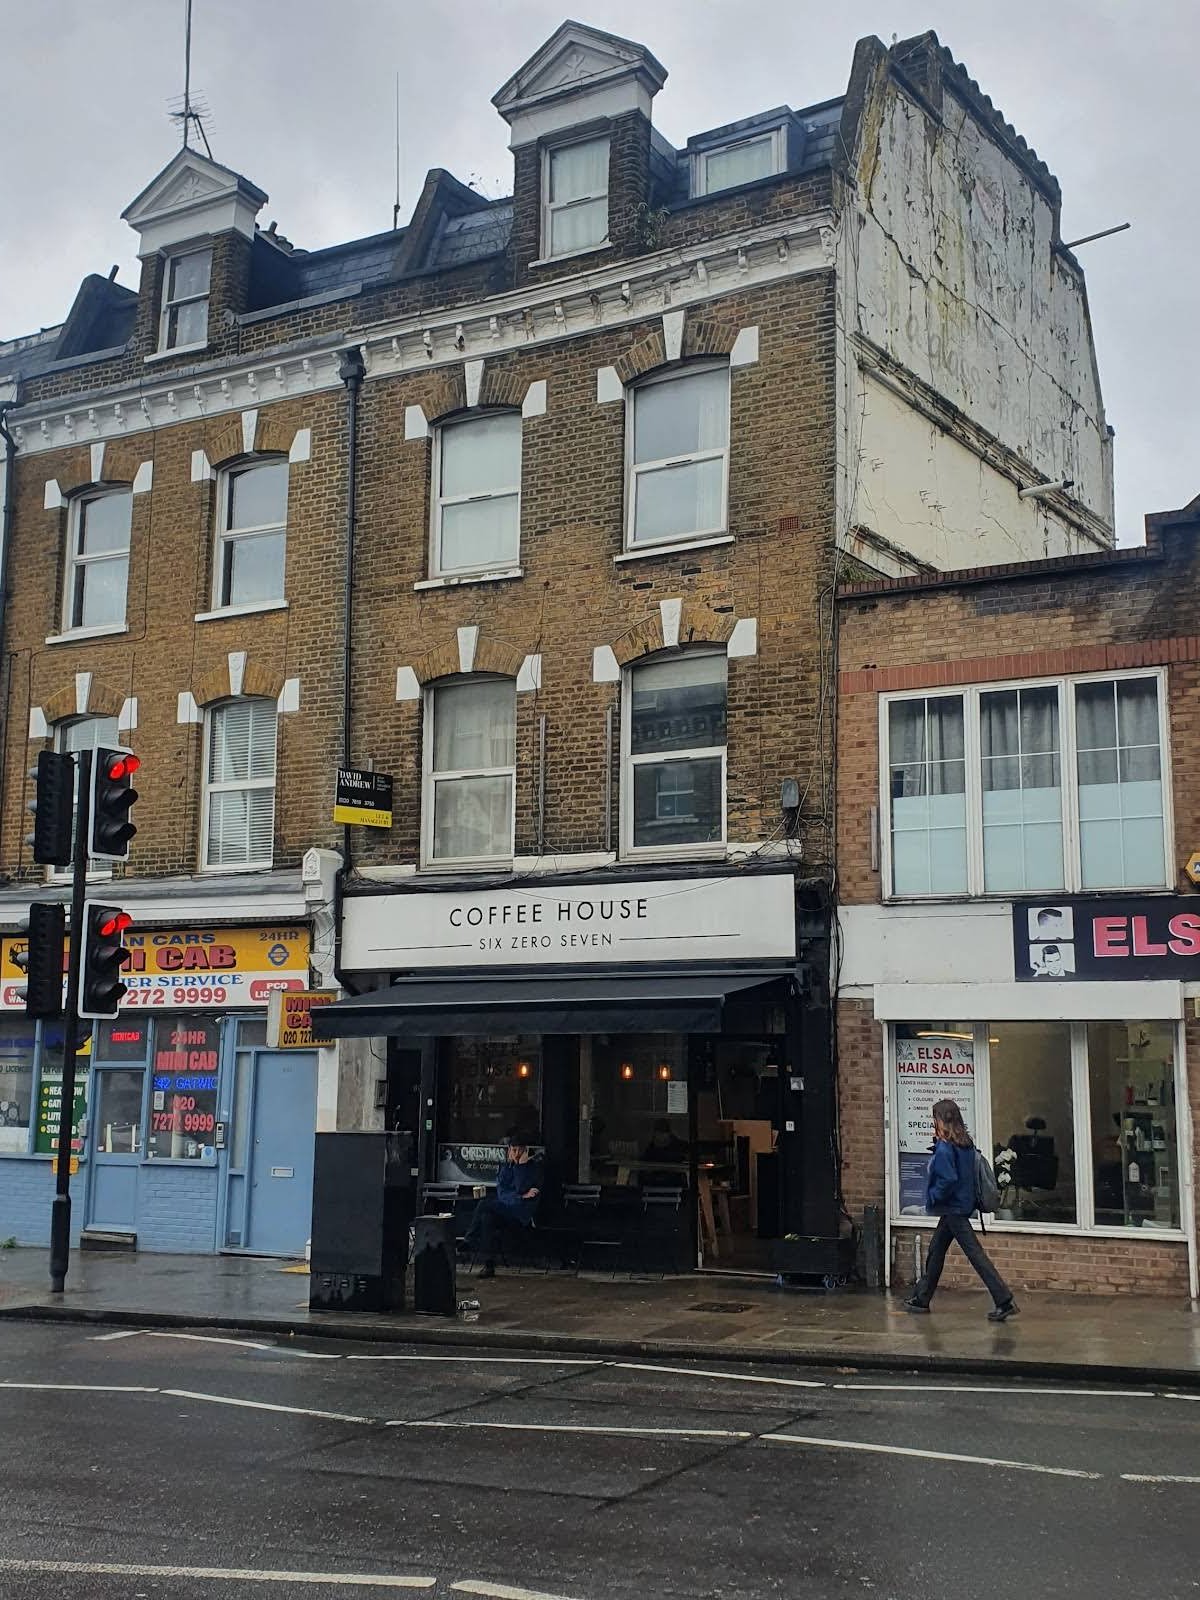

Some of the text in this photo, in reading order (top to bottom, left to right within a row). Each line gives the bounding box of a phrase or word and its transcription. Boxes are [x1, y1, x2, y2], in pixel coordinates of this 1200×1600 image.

[340, 771, 361, 780] DAVID
[340, 779, 371, 789] ANDREW
[450, 899, 647, 926] COFFEE HOUSE
[152, 934, 216, 945] CARS
[259, 931, 299, 941] 24HR
[479, 932, 612, 950] SIX ZERO SEVEN
[156, 945, 236, 971] CAB
[157, 974, 244, 986] SERVICE
[173, 987, 227, 1003] 9999
[286, 1013, 312, 1029] CA
[171, 1031, 206, 1045] 24HR
[283, 1031, 298, 1044] 020
[157, 1051, 218, 1071] MINI CAB
[918, 1048, 953, 1060] ELSA
[898, 1063, 974, 1075] HAIR SALON
[174, 1096, 195, 1110] 020
[184, 1114, 214, 1131] 9999
[461, 1146, 505, 1161] CHRISTMAS
